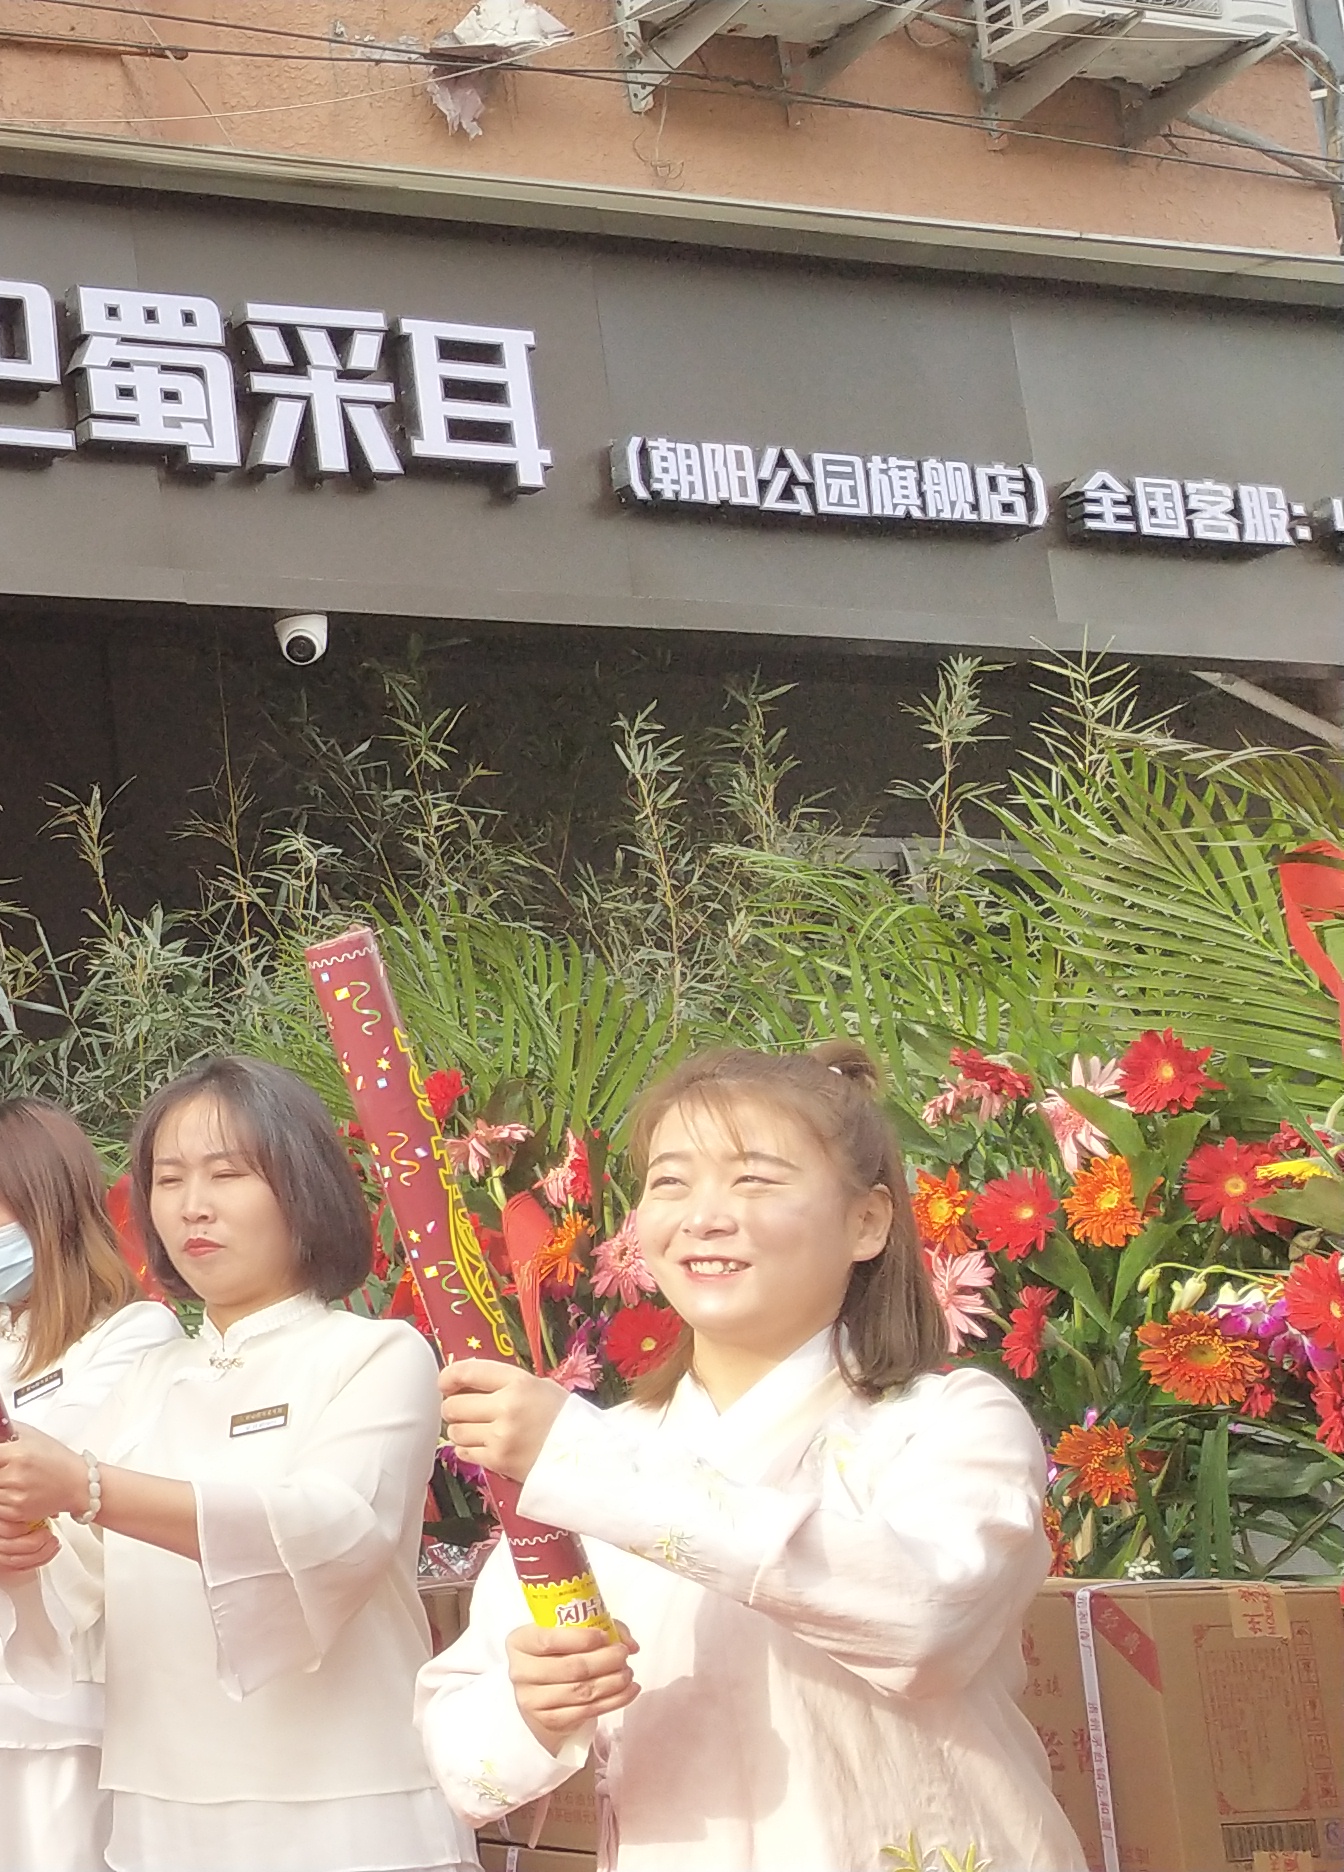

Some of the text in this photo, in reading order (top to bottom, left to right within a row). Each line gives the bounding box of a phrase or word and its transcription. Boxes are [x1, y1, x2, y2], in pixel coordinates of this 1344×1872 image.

[622, 435, 1051, 529] (朝阳公园旗舰店)
